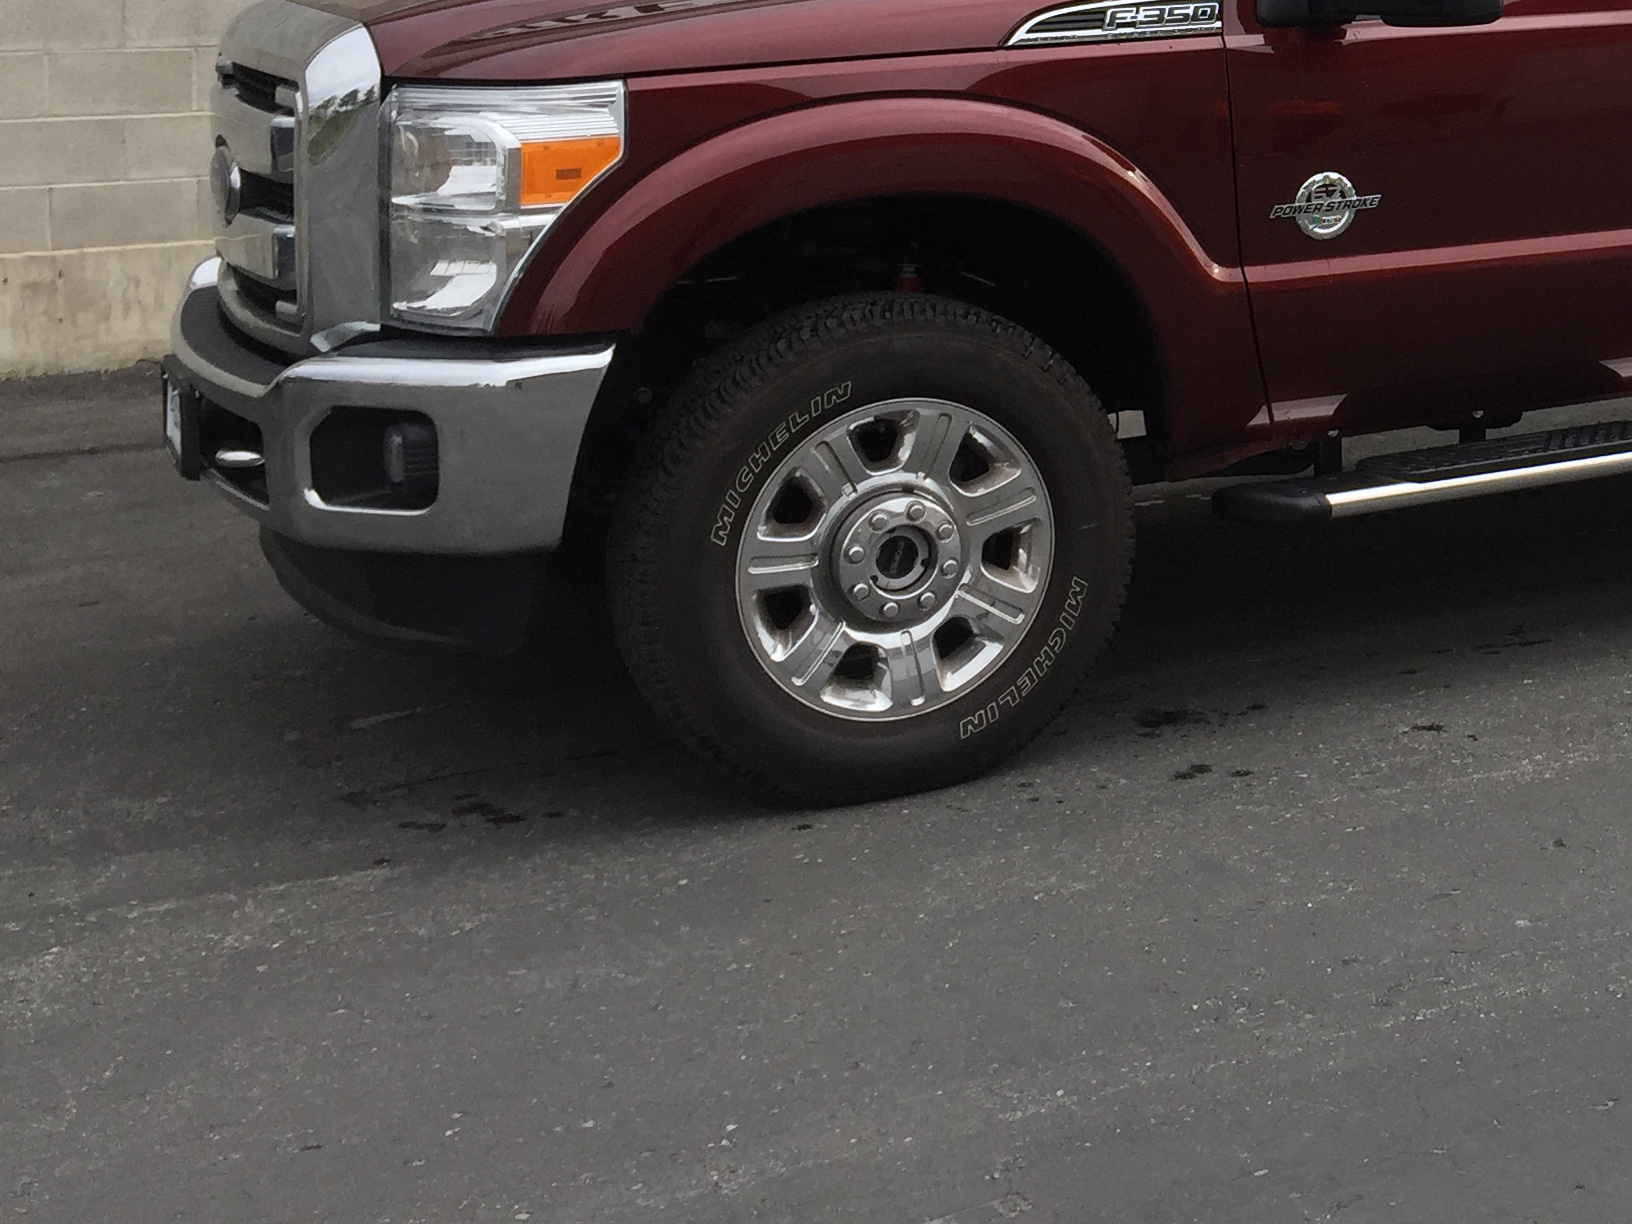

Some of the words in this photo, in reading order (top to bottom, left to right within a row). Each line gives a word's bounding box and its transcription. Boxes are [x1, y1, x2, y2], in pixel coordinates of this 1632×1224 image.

[1102, 2, 1220, 31] F-350
[1271, 202, 1325, 217] POWER
[1325, 196, 1380, 212] STROKE
[710, 380, 852, 547] MICHELIN
[959, 577, 1088, 740] MICHELIN
